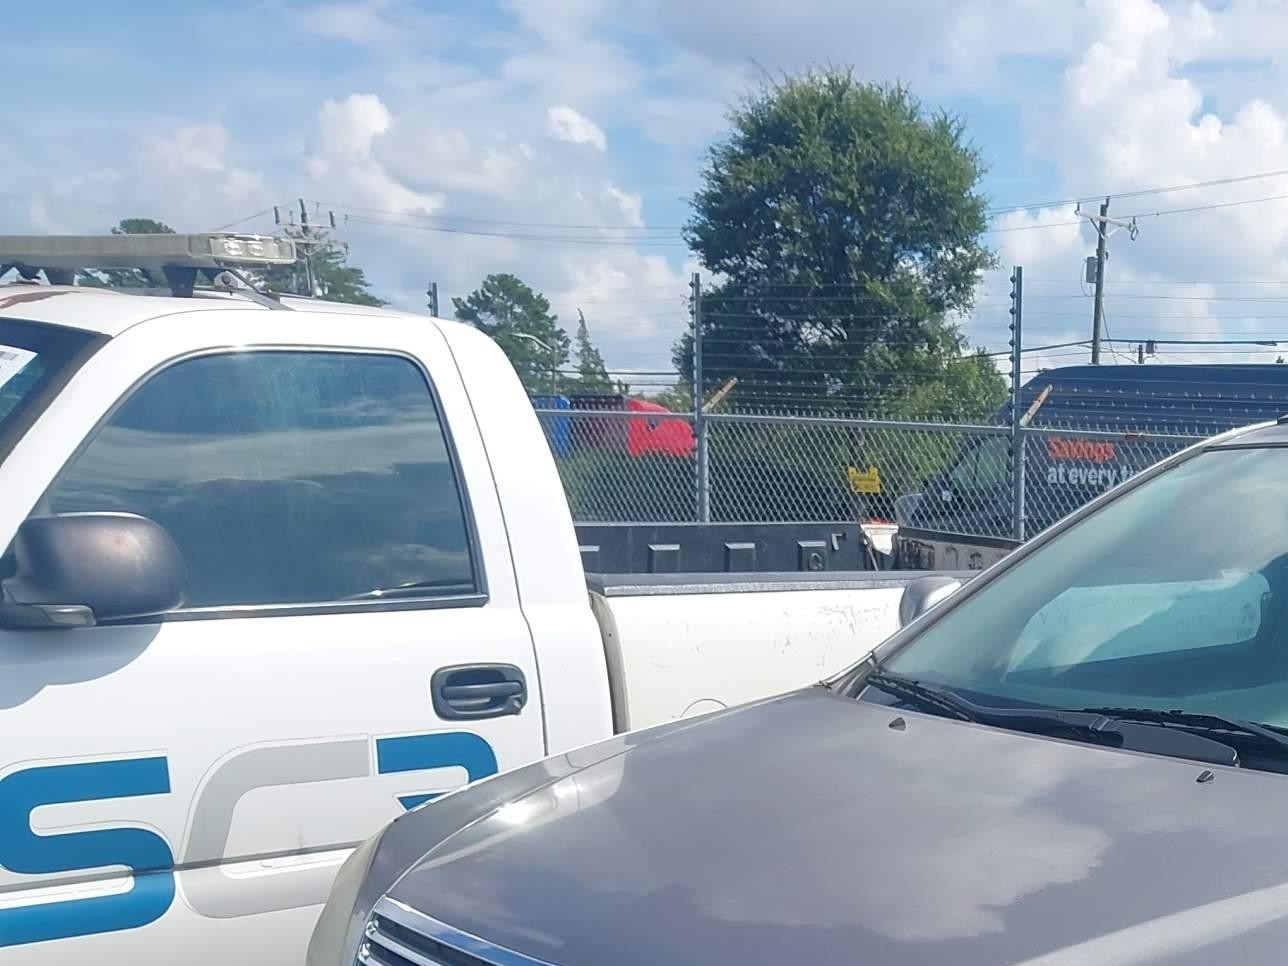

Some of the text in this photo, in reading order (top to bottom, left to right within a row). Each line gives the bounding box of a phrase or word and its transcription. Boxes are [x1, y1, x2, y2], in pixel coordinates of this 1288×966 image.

[1048, 437, 1115, 463] Savings
[1047, 465, 1066, 483] at
[1068, 467, 1118, 490] every
